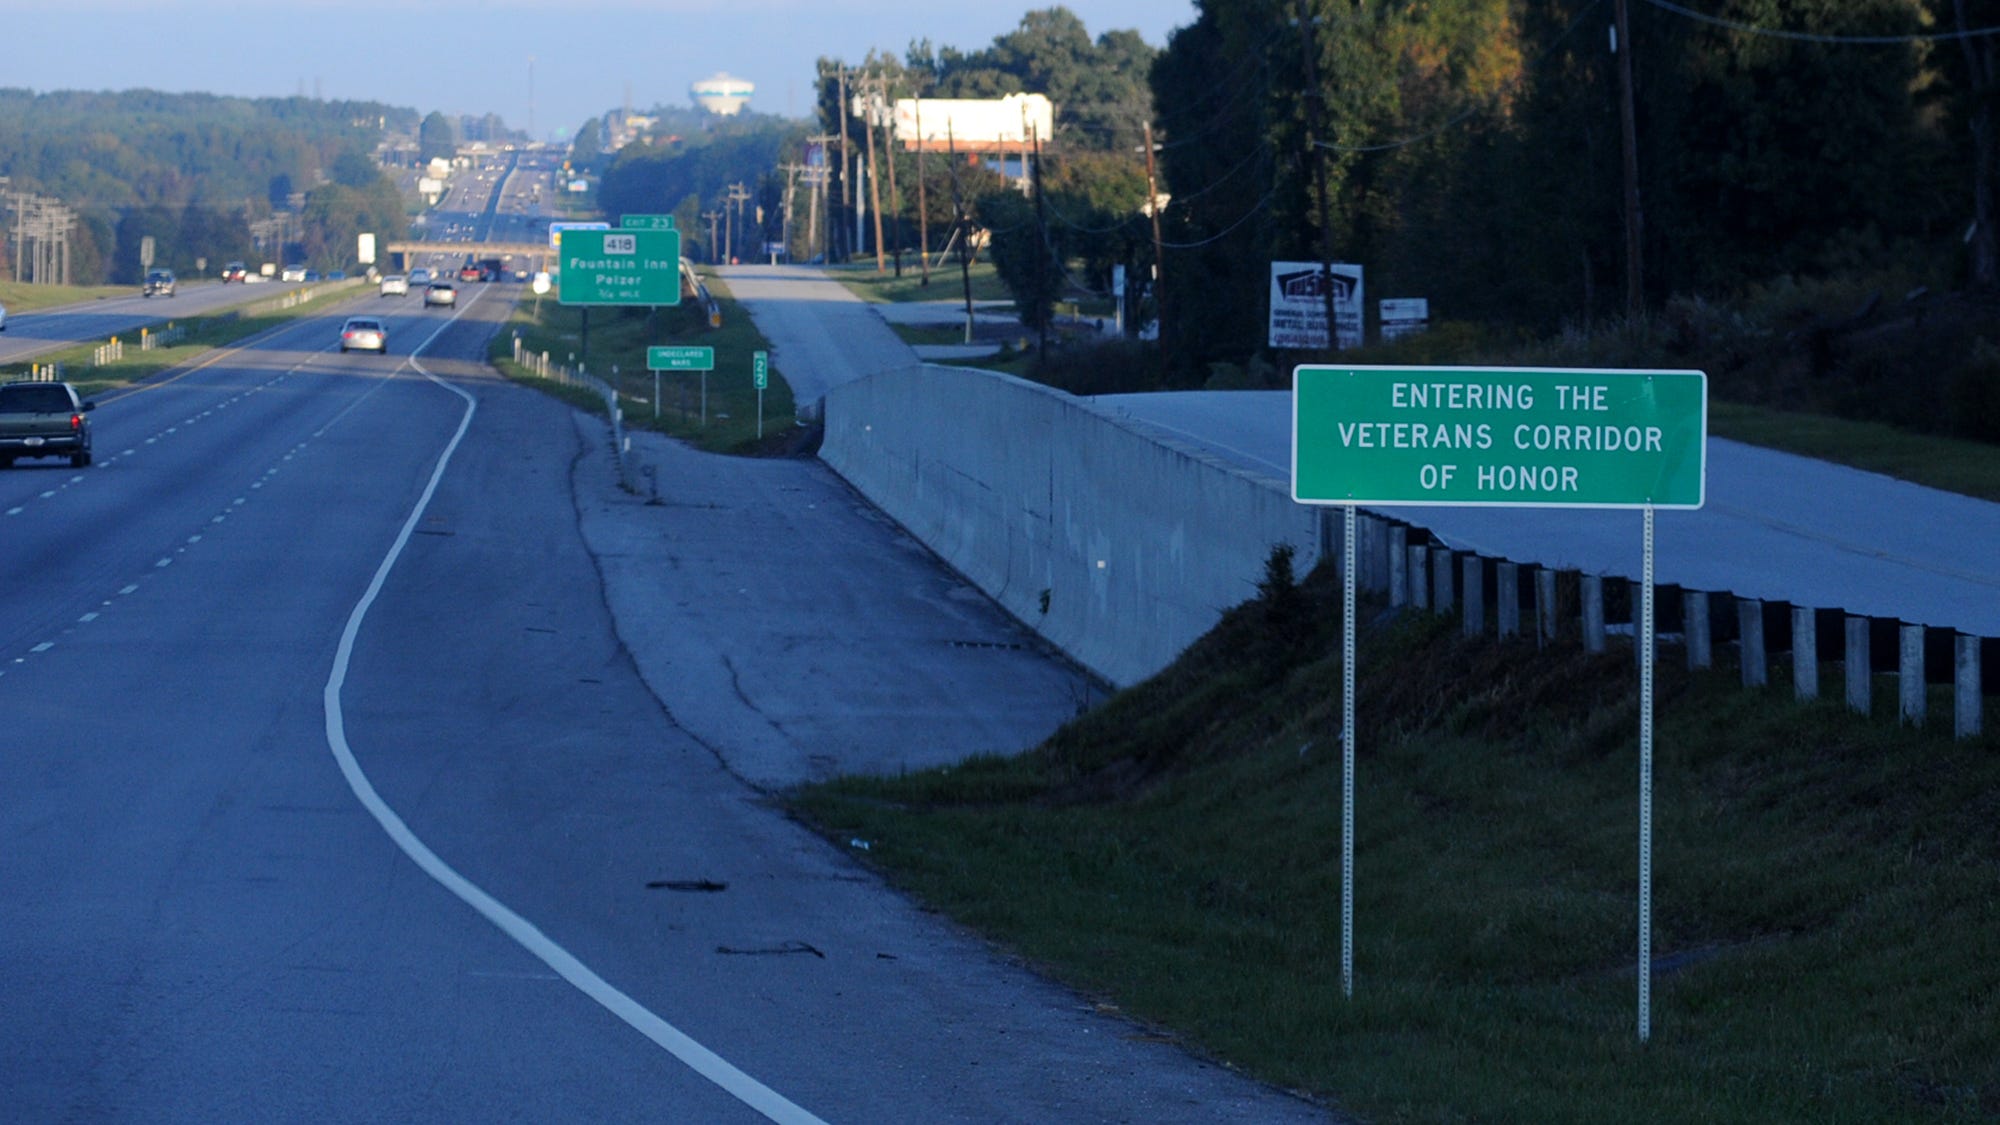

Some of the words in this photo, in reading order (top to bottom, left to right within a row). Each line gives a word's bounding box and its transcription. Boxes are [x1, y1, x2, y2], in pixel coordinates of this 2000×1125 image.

[625, 218, 646, 227] EXIT
[651, 217, 669, 229] 23
[606, 238, 633, 250] 418
[570, 257, 636, 269] Fountain
[644, 258, 668, 270] Inn
[595, 274, 642, 286] Pelzer
[619, 290, 640, 298] MILE
[1392, 382, 1534, 410] ENTERING
[1555, 385, 1609, 411] THE
[1337, 422, 1493, 449] VETERANS
[1513, 424, 1663, 452] CORRIDOR
[1419, 464, 1457, 490] OF
[1477, 466, 1579, 492] HONOR
